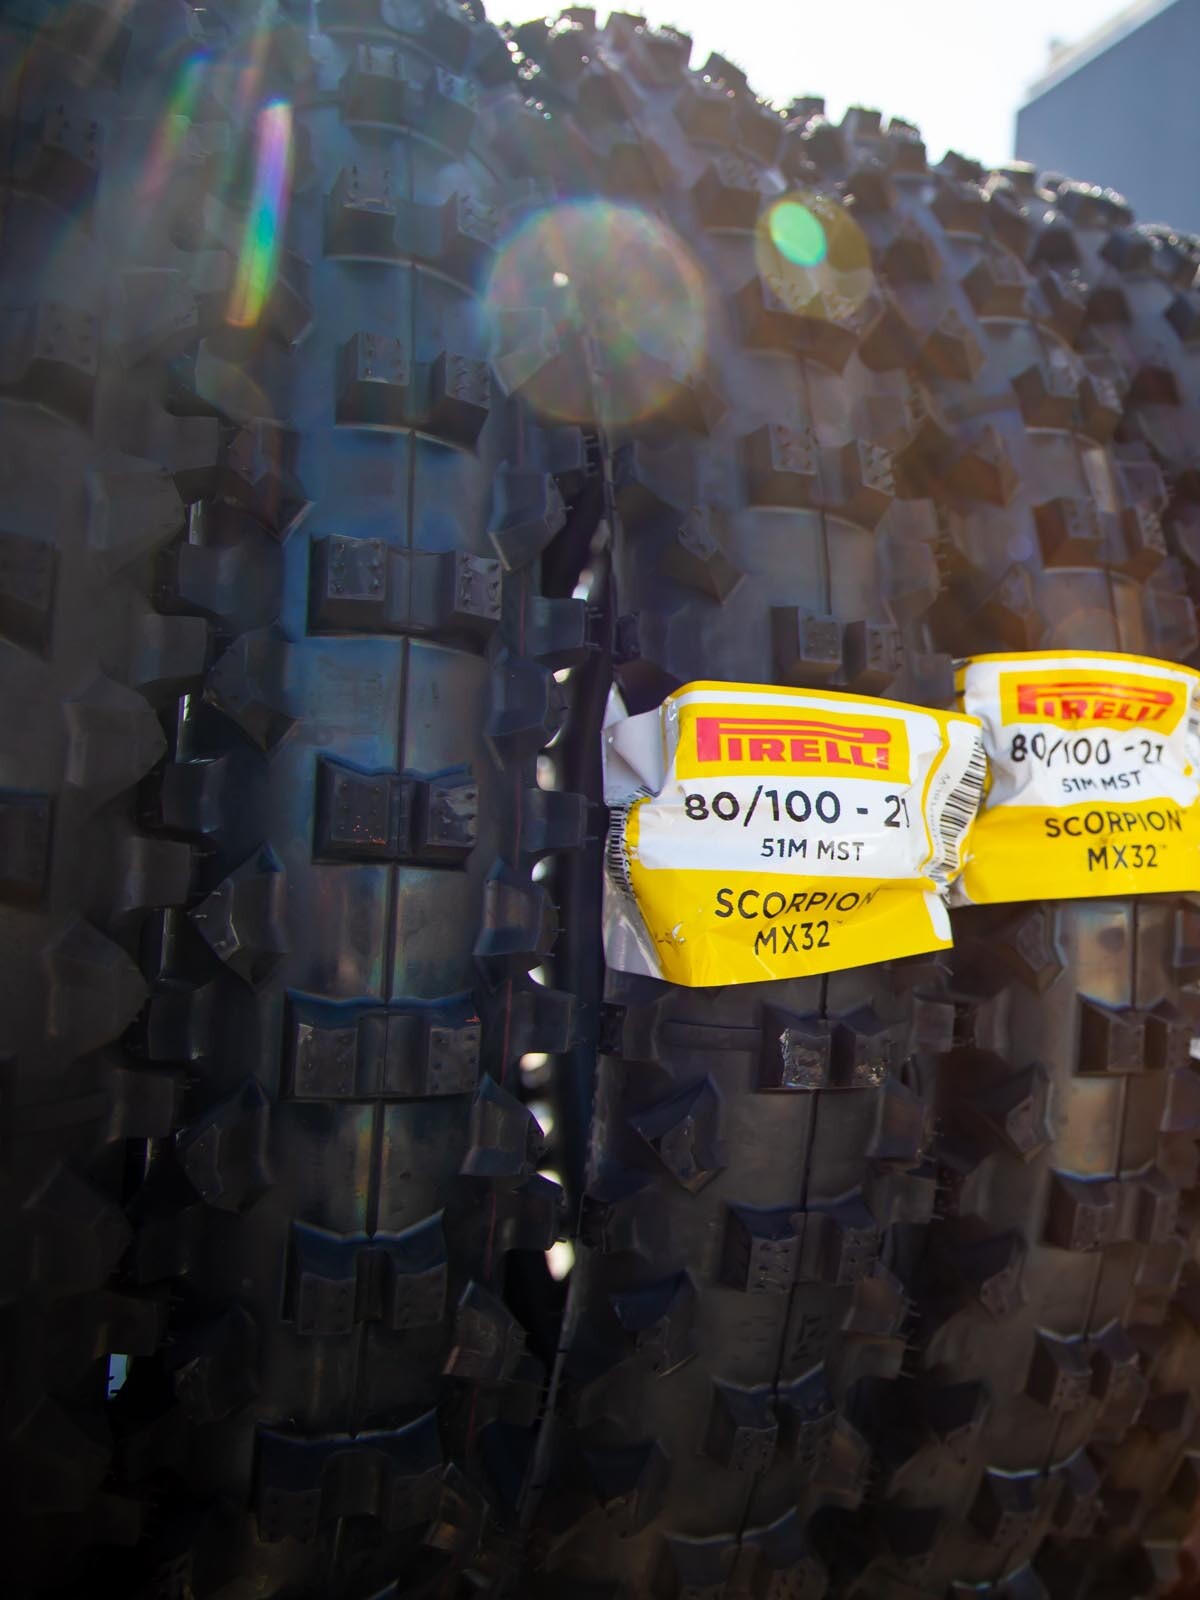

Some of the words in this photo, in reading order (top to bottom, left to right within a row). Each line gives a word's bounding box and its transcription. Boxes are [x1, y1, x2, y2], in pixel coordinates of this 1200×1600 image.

[1017, 682, 1175, 722] PIRELLI
[696, 716, 892, 771] PIRELLI
[1010, 732, 1111, 767] 80/100
[1062, 776, 1097, 793] 51M
[1102, 769, 1143, 791] MST
[685, 784, 841, 827] 80/100
[884, 794, 911, 829] 21
[1044, 809, 1182, 838] SCORPION
[760, 838, 808, 859] 51M
[816, 841, 865, 861] MST
[1087, 843, 1159, 872] MX32
[714, 886, 882, 919] SCORPION
[753, 920, 831, 956] MX32
